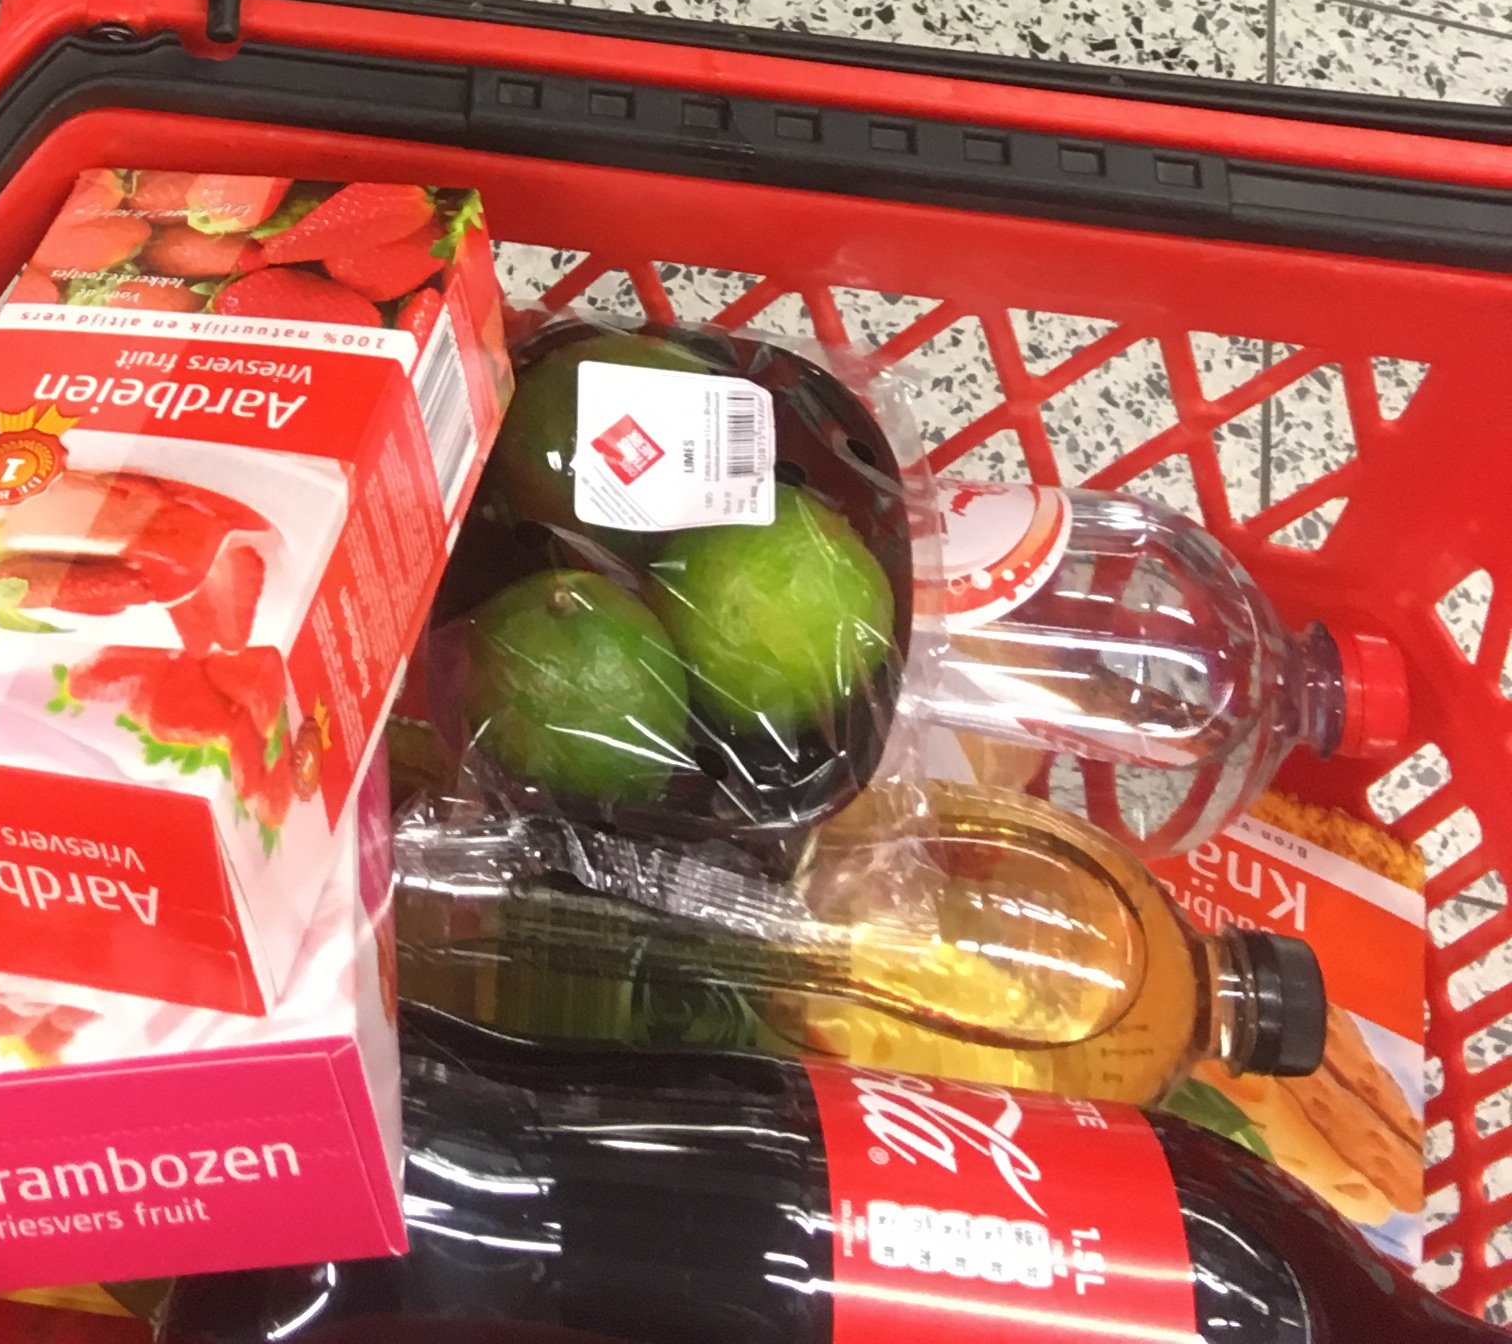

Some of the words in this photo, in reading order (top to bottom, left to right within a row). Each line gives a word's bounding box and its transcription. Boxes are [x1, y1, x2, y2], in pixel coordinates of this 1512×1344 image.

[20, 310, 66, 322] vers
[76, 313, 142, 329] altijd
[153, 318, 178, 330] en
[190, 320, 309, 340] natuurlijk
[322, 330, 386, 351] 100%
[115, 348, 180, 371] fruit
[185, 354, 313, 386] Vriesvers
[33, 372, 309, 431] Aardbeien
[682, 439, 696, 474] LIMES
[0, 457, 26, 483] 1
[4, 827, 146, 873] Vriesvers
[1261, 830, 1308, 859] Bron
[135, 1198, 209, 1227] fruit
